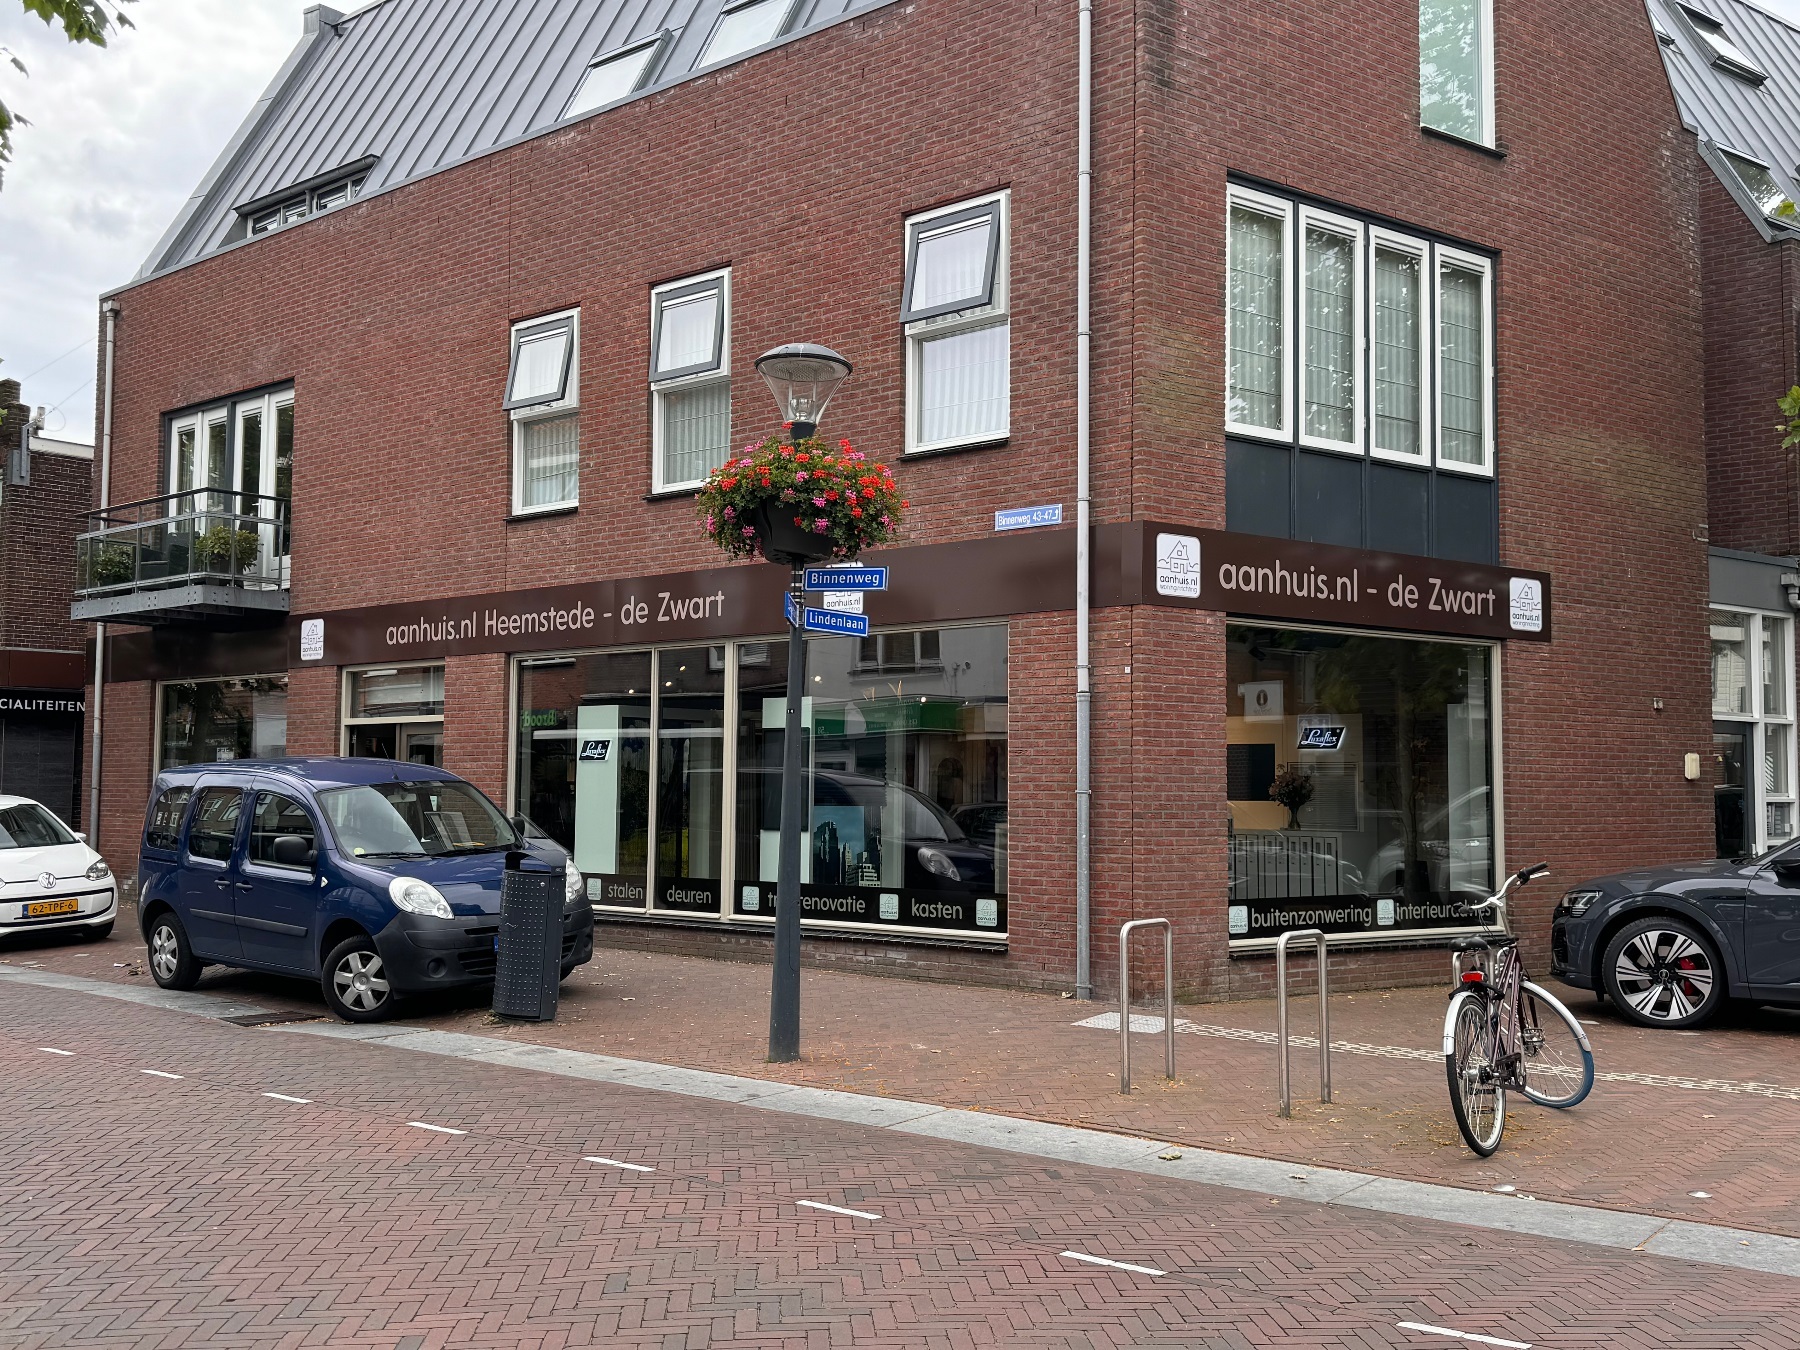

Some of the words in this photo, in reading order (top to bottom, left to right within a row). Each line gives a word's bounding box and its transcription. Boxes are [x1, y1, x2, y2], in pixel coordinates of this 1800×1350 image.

[998, 513, 1030, 526] Binnenweg
[1033, 509, 1053, 522] 43-47
[811, 572, 880, 587] Binnenweg
[1159, 574, 1198, 586] aanhuis.nl
[1218, 559, 1358, 603] aanhuis.nl
[1387, 574, 1419, 609] de
[1428, 577, 1496, 617] Zwart
[826, 597, 861, 608] aanhuis.nl
[386, 611, 477, 645] aanhuis.nl
[484, 600, 595, 637] Heemstede
[620, 595, 649, 625] de
[657, 590, 725, 622] Zwart
[809, 611, 864, 630] Lindenlaan
[1301, 729, 1338, 748] Luxaflex
[608, 882, 643, 900] stalen
[666, 885, 712, 904] deuren
[32, 901, 74, 914] 62-TPF-6
[911, 897, 963, 920] kasten
[1251, 904, 1372, 928] buitenzonwering
